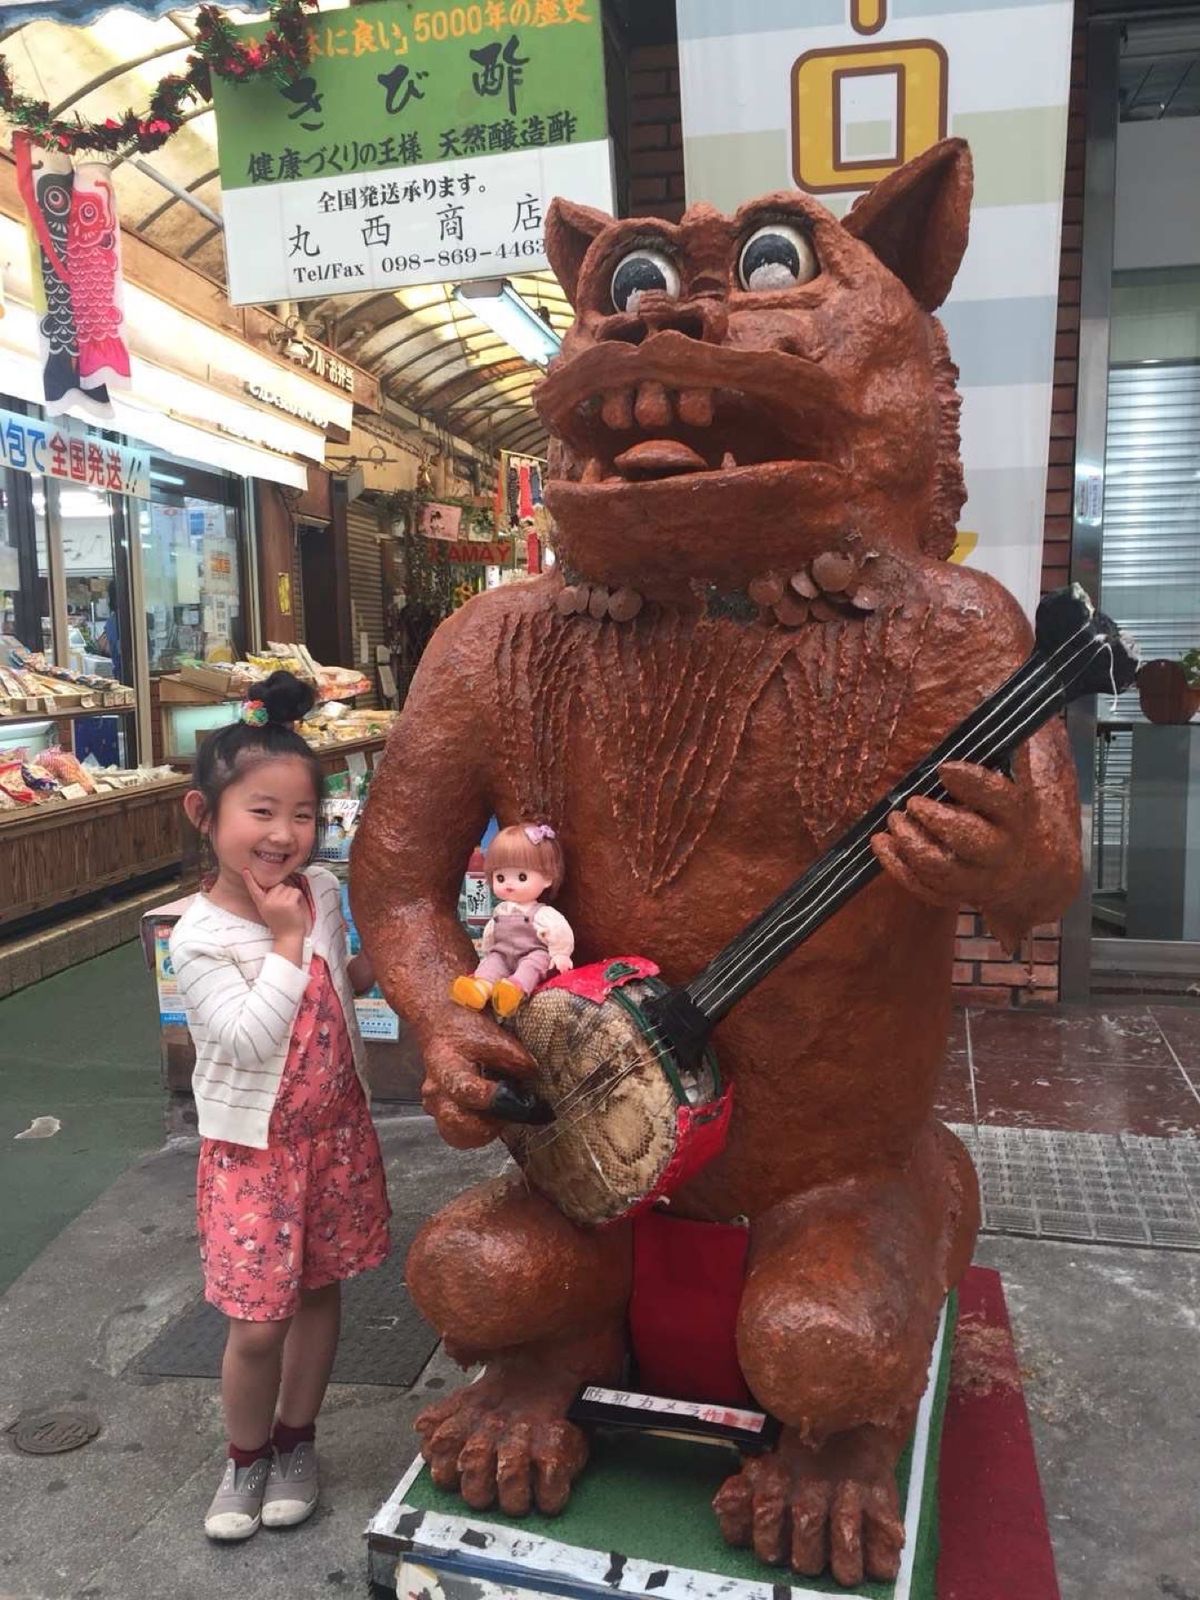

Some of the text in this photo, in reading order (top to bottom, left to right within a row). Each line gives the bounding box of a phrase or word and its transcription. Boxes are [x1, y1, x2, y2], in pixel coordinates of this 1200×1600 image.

[247, 110, 578, 184] 健康づくりの王様 天然醸造酢
[317, 173, 486, 214] 全国発送承ります。
[288, 192, 542, 258] 丸西商店
[293, 238, 547, 283] Tel/Fax 098-869-4463
